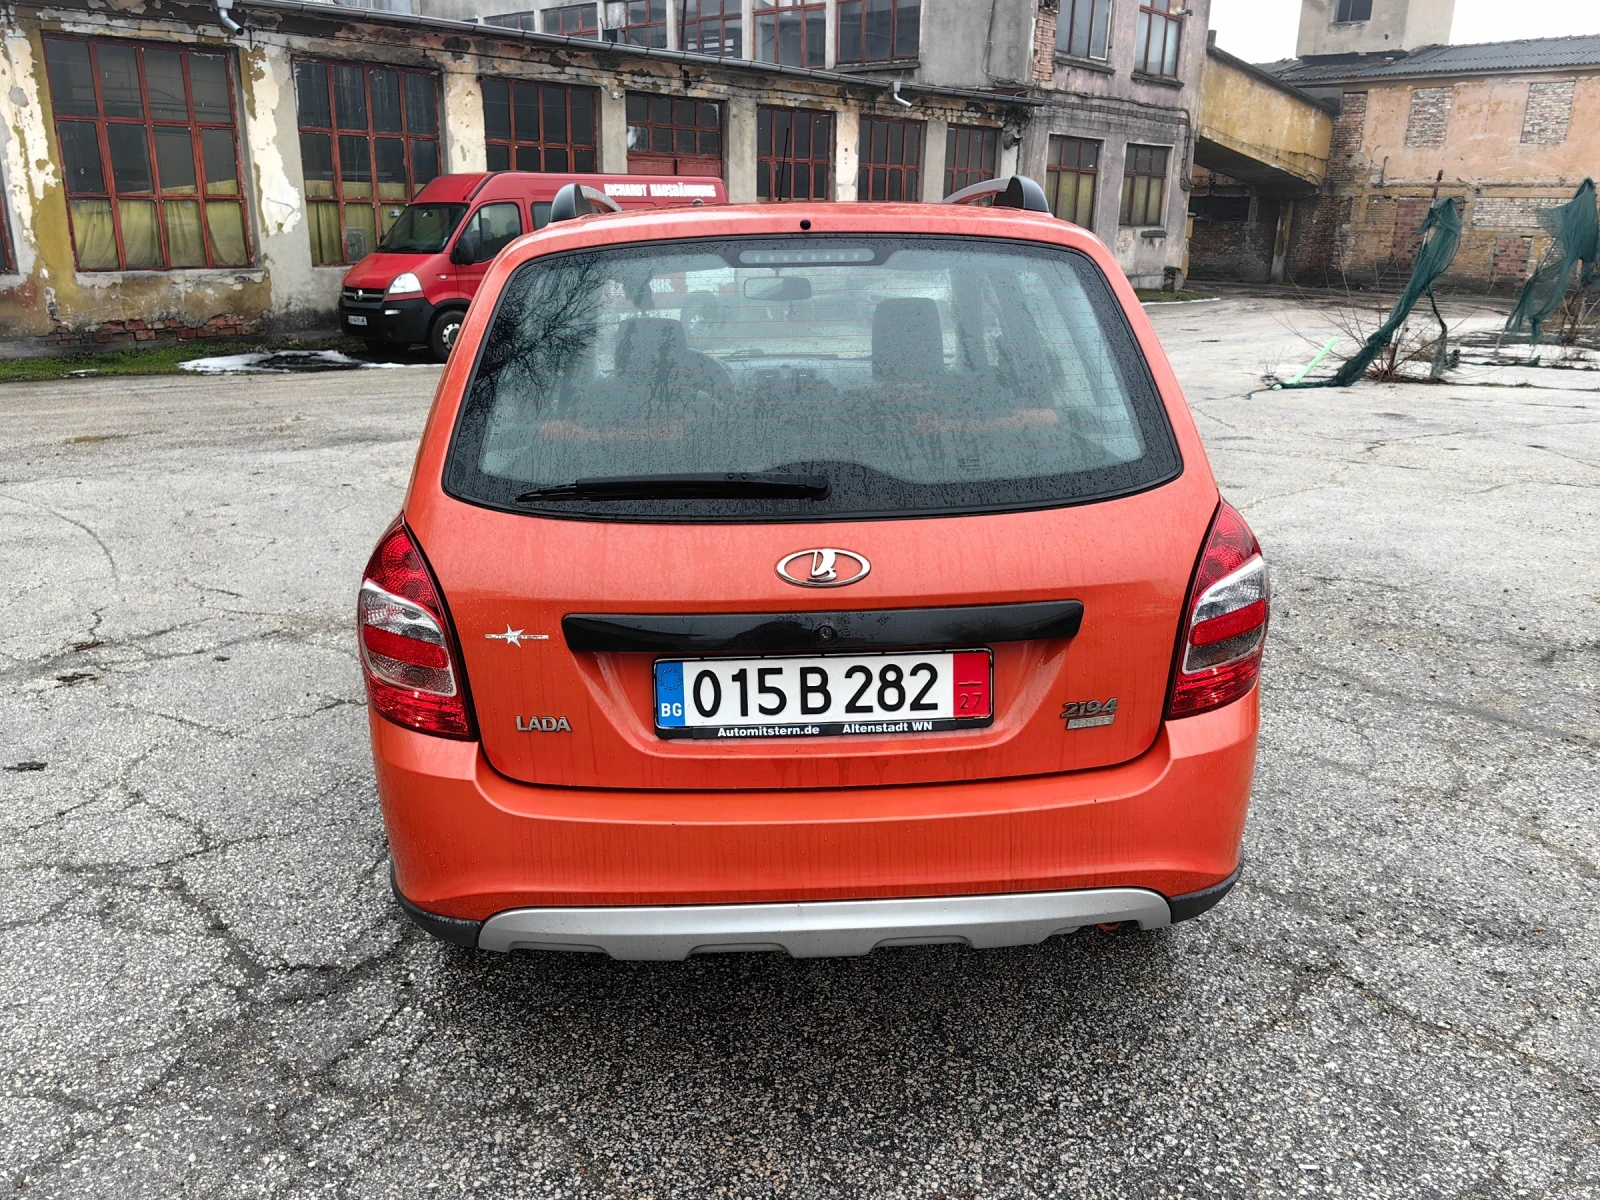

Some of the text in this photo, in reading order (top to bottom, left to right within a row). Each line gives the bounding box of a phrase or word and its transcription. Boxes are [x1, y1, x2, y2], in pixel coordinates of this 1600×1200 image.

[661, 702, 682, 717] BG
[959, 692, 982, 710] 27
[1061, 697, 1118, 718] 2194
[516, 715, 572, 732] LADA
[717, 721, 933, 738] Automitstern.de Altenstadt WN
